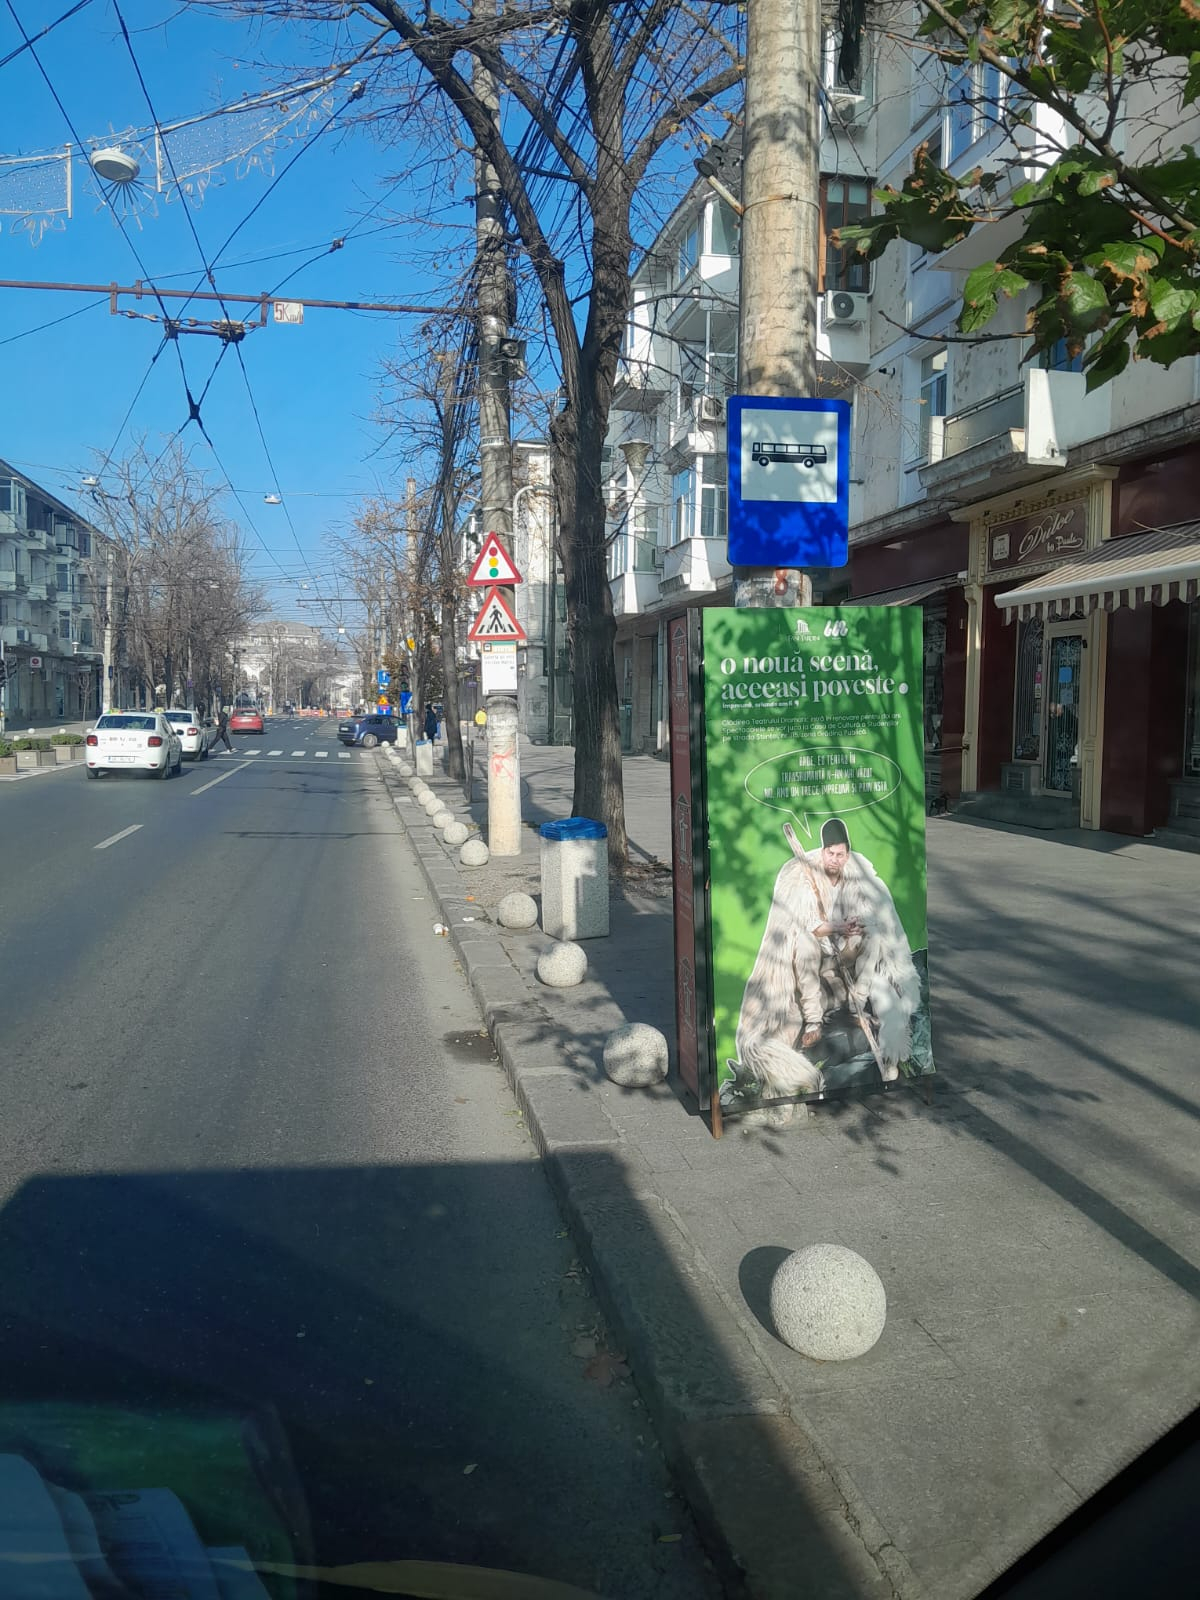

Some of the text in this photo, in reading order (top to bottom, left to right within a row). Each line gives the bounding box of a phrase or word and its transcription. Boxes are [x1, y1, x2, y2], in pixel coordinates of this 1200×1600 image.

[720, 649, 879, 675] o nouă scenă,
